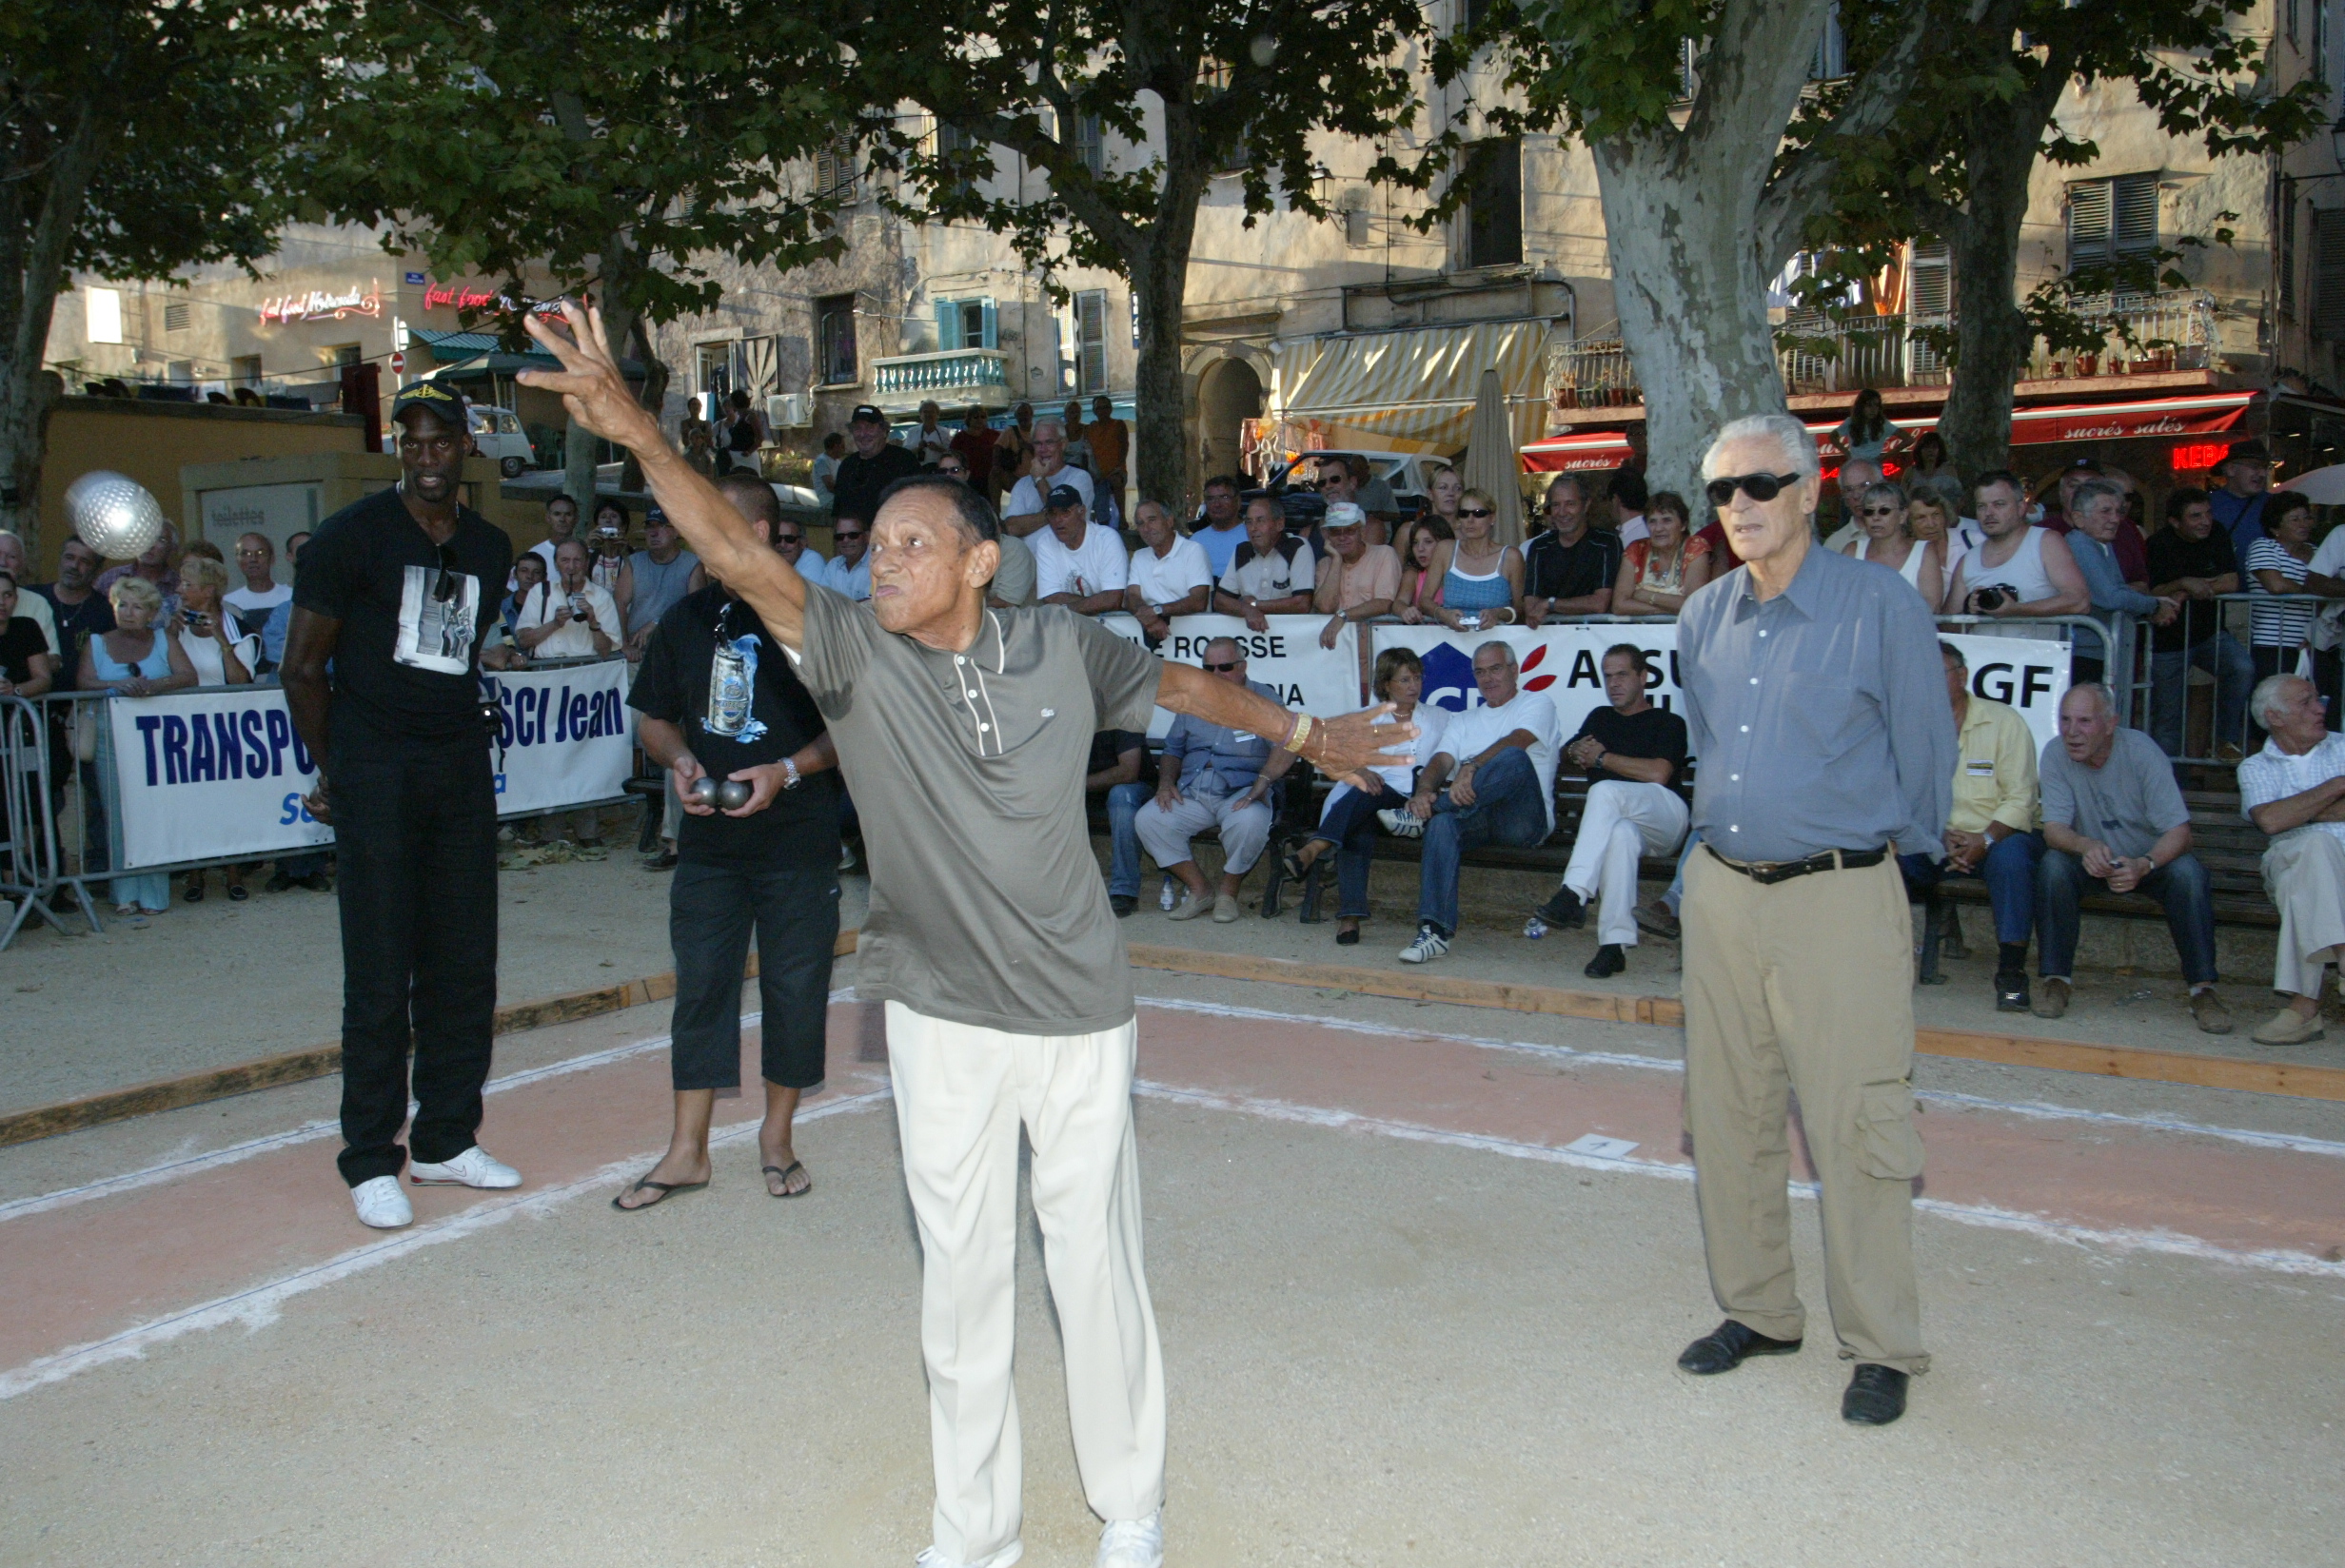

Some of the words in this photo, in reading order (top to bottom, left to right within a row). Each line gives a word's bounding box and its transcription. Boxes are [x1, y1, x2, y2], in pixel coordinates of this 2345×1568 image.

[424, 282, 454, 310] fast
[2064, 421, 2125, 440] sucrés
[2134, 415, 2187, 436] salés
[555, 685, 624, 743] Jean
